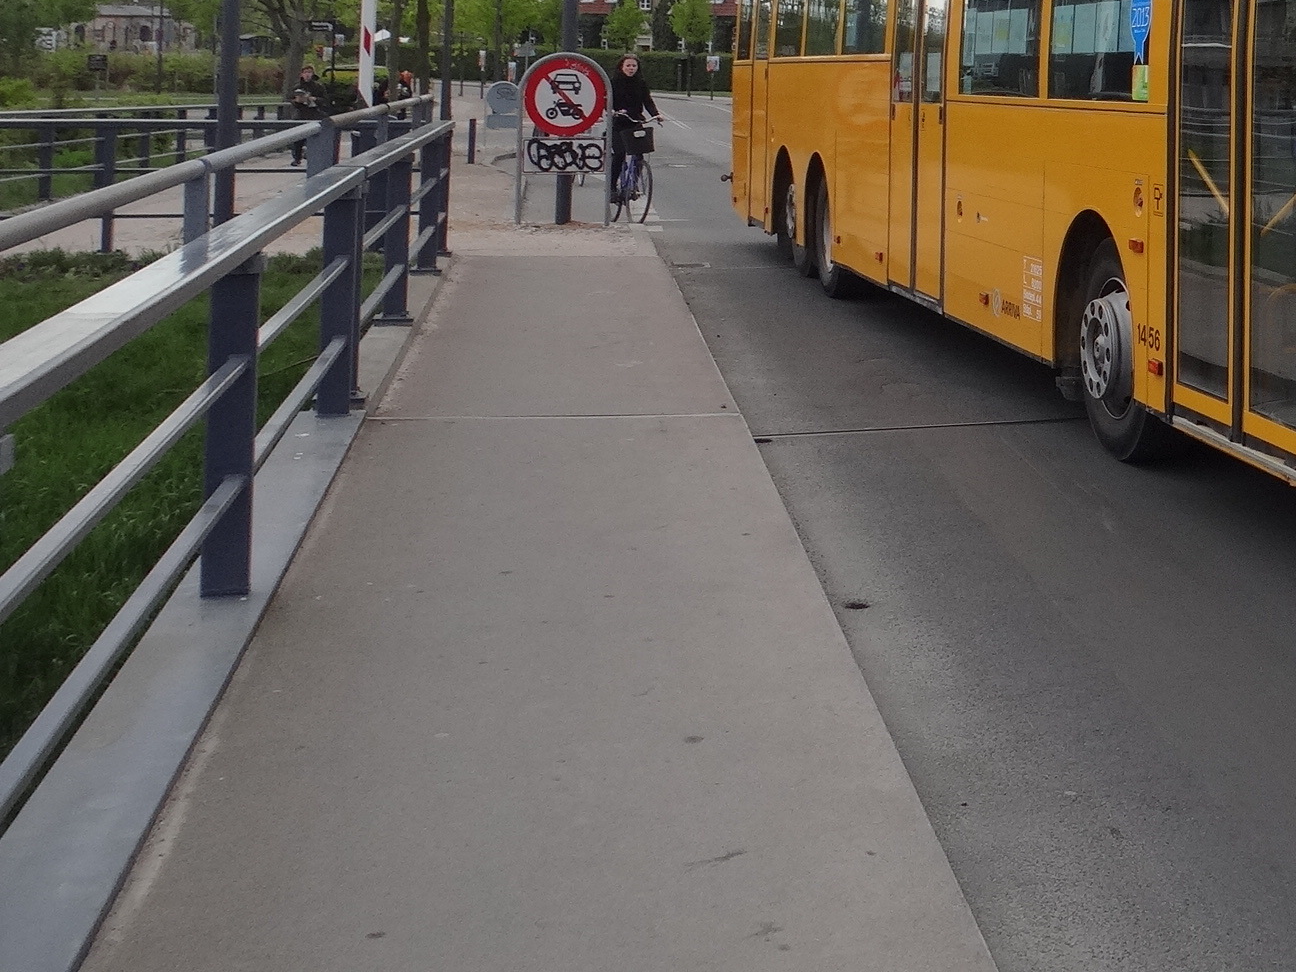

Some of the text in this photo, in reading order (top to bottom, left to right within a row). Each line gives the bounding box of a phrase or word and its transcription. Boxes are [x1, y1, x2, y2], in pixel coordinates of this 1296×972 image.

[1131, 6, 1150, 28] 2013
[1001, 298, 1021, 320] ARRIVA
[1136, 322, 1161, 352] 1456
